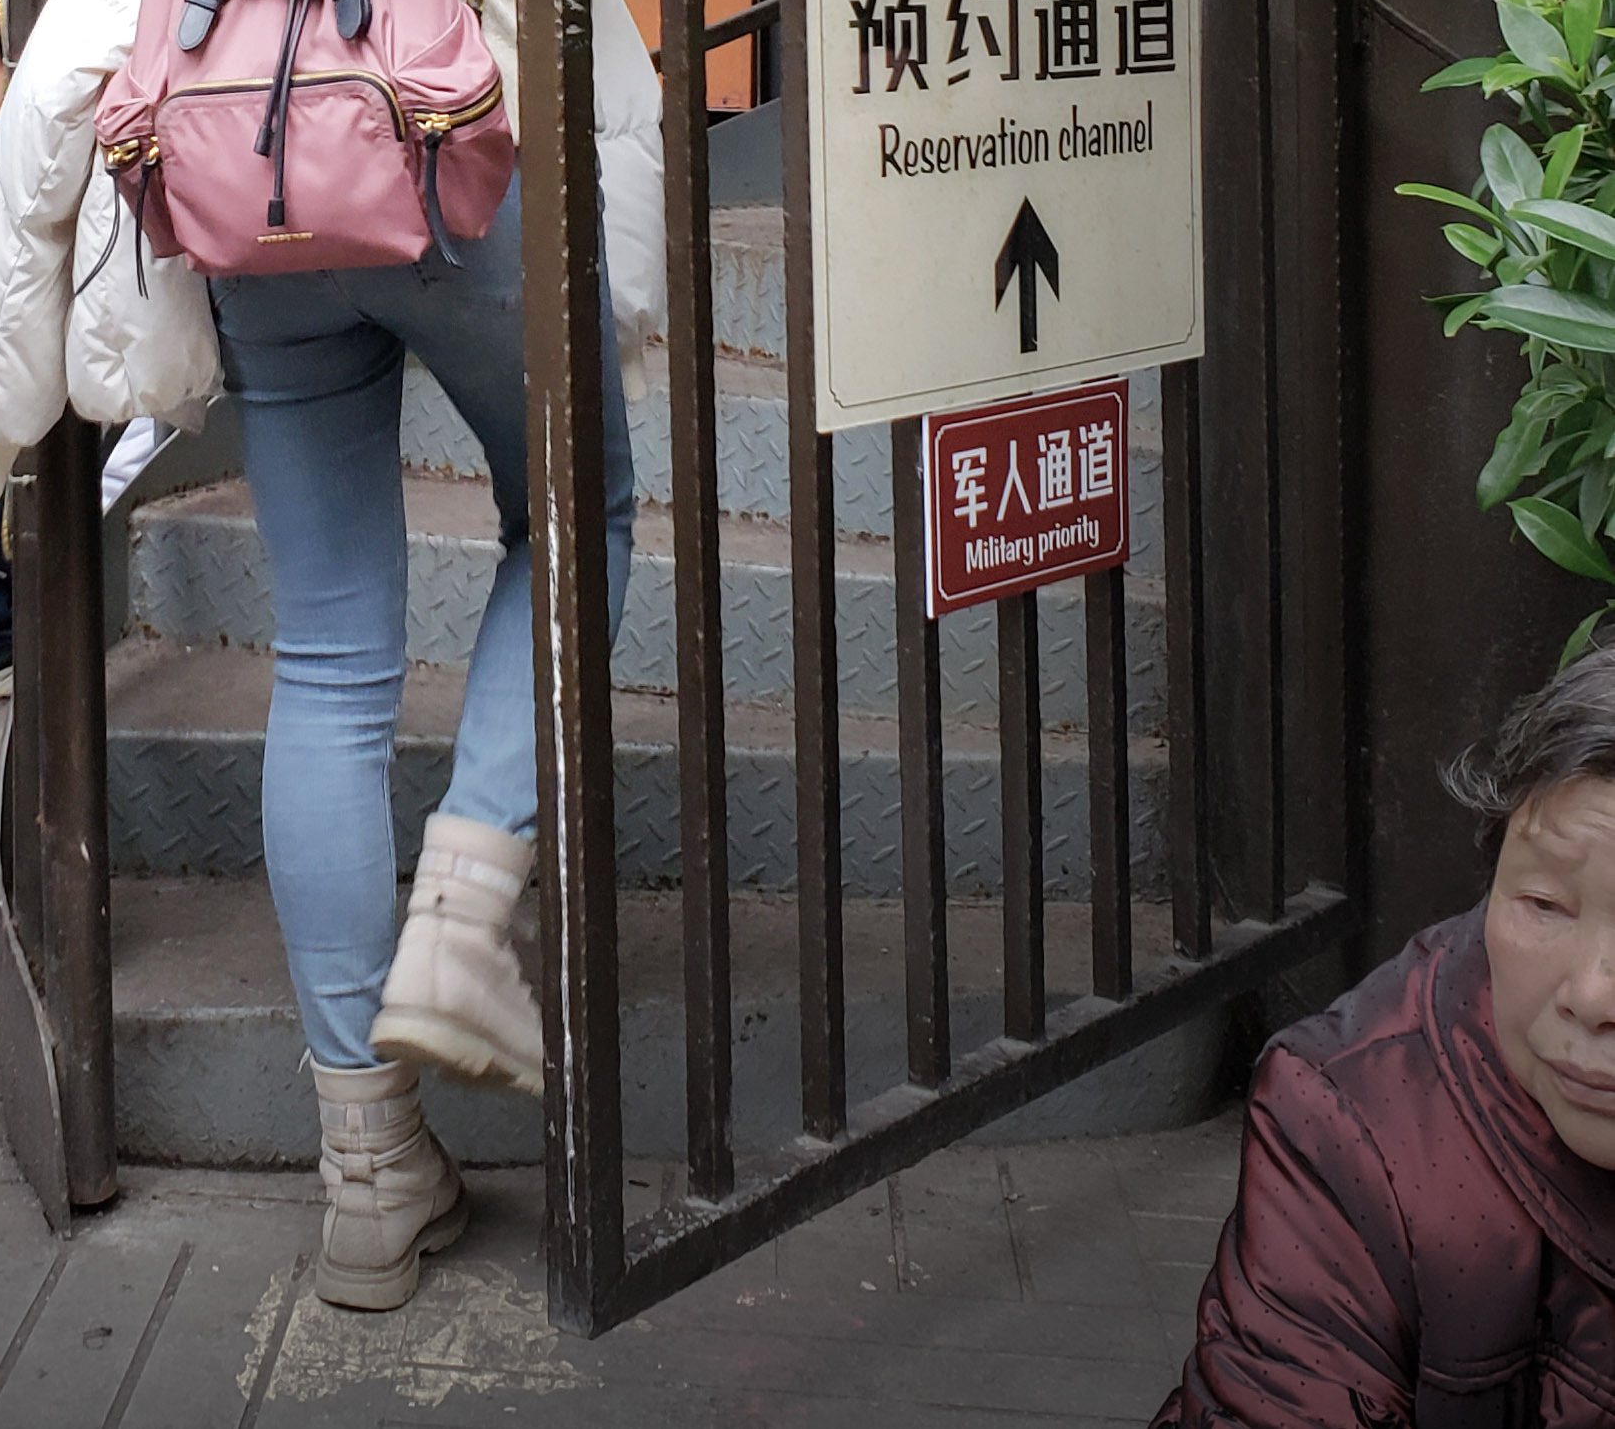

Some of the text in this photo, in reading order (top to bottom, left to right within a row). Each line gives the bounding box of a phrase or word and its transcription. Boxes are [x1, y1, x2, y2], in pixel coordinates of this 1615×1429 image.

[878, 99, 1154, 178] Reservation channel
[951, 420, 1114, 529] 军人通道
[965, 514, 1100, 574] Military priority
